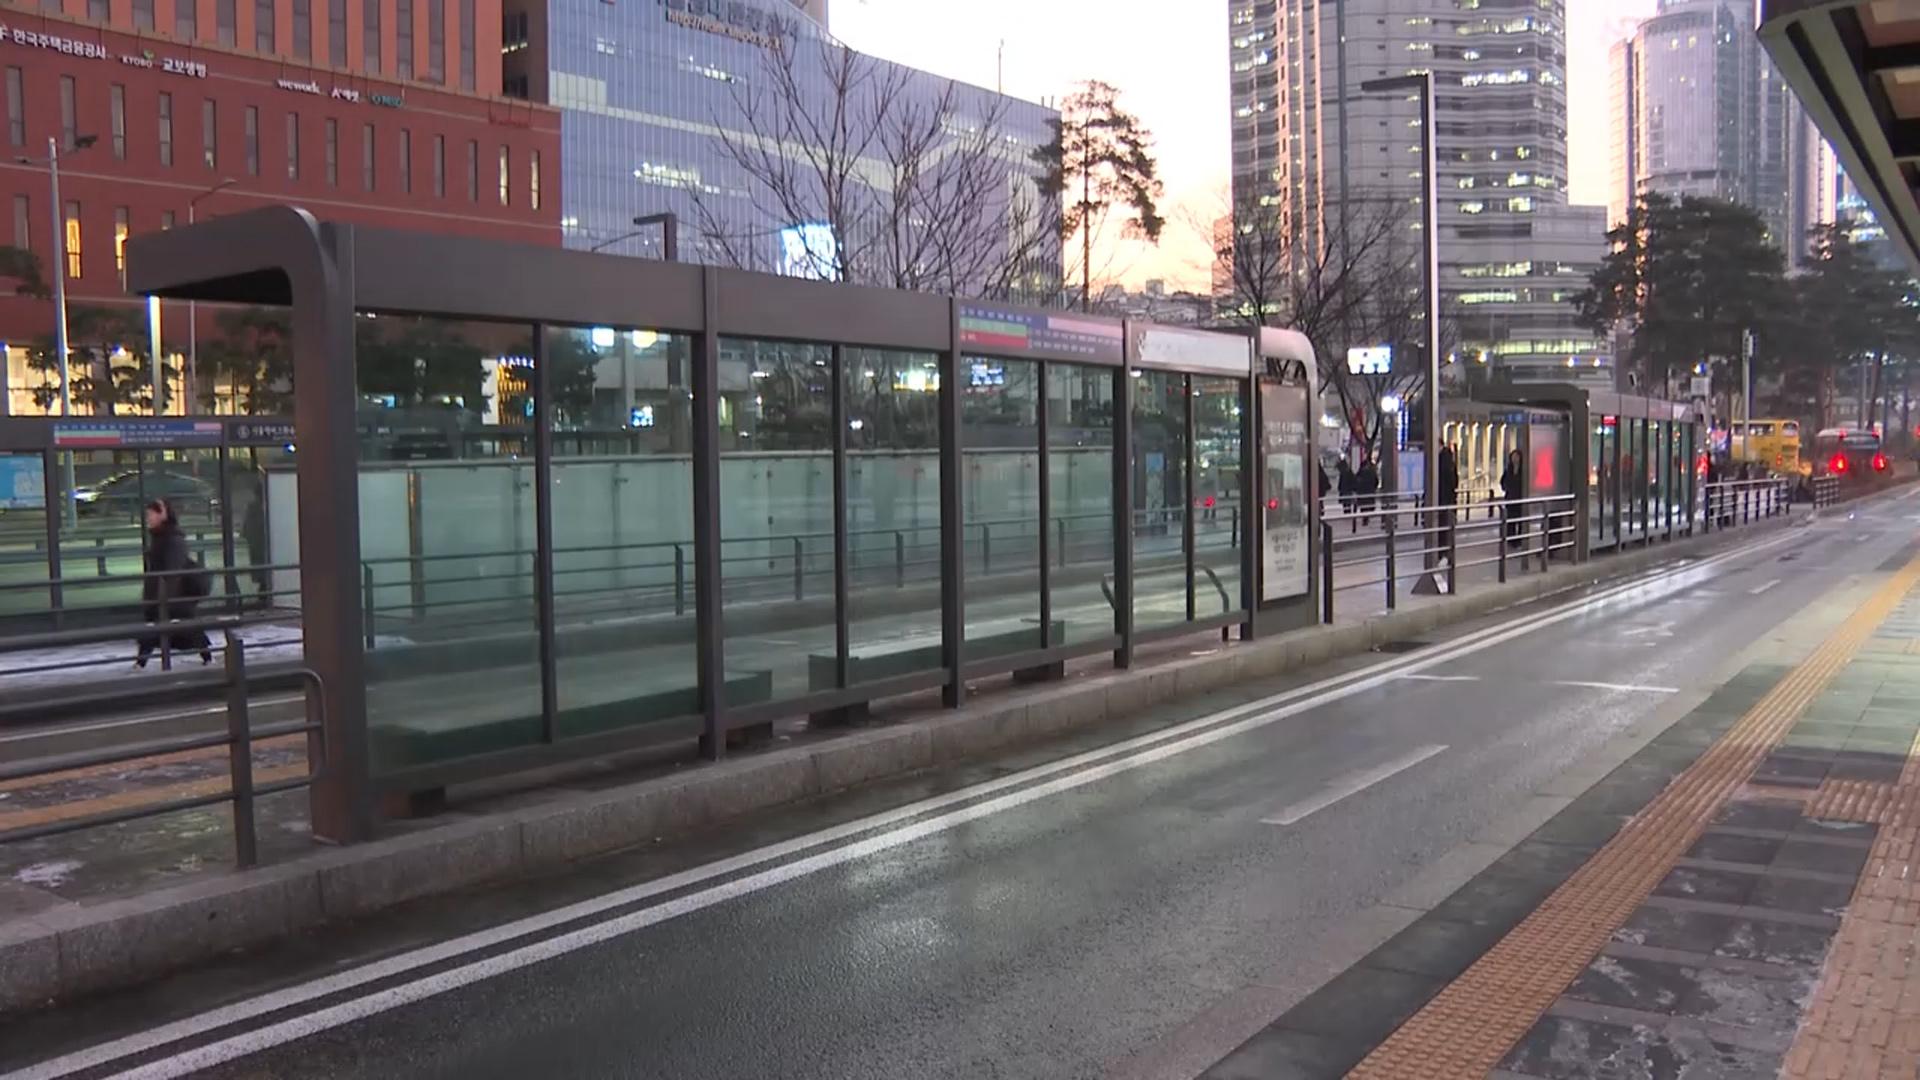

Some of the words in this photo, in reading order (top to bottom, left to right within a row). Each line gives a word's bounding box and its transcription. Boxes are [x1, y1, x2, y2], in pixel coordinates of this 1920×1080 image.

[13, 28, 106, 60] 한국주택금융공사
[122, 55, 152, 69] KYOBO
[163, 58, 207, 78] 교보생명
[277, 79, 320, 94] wework
